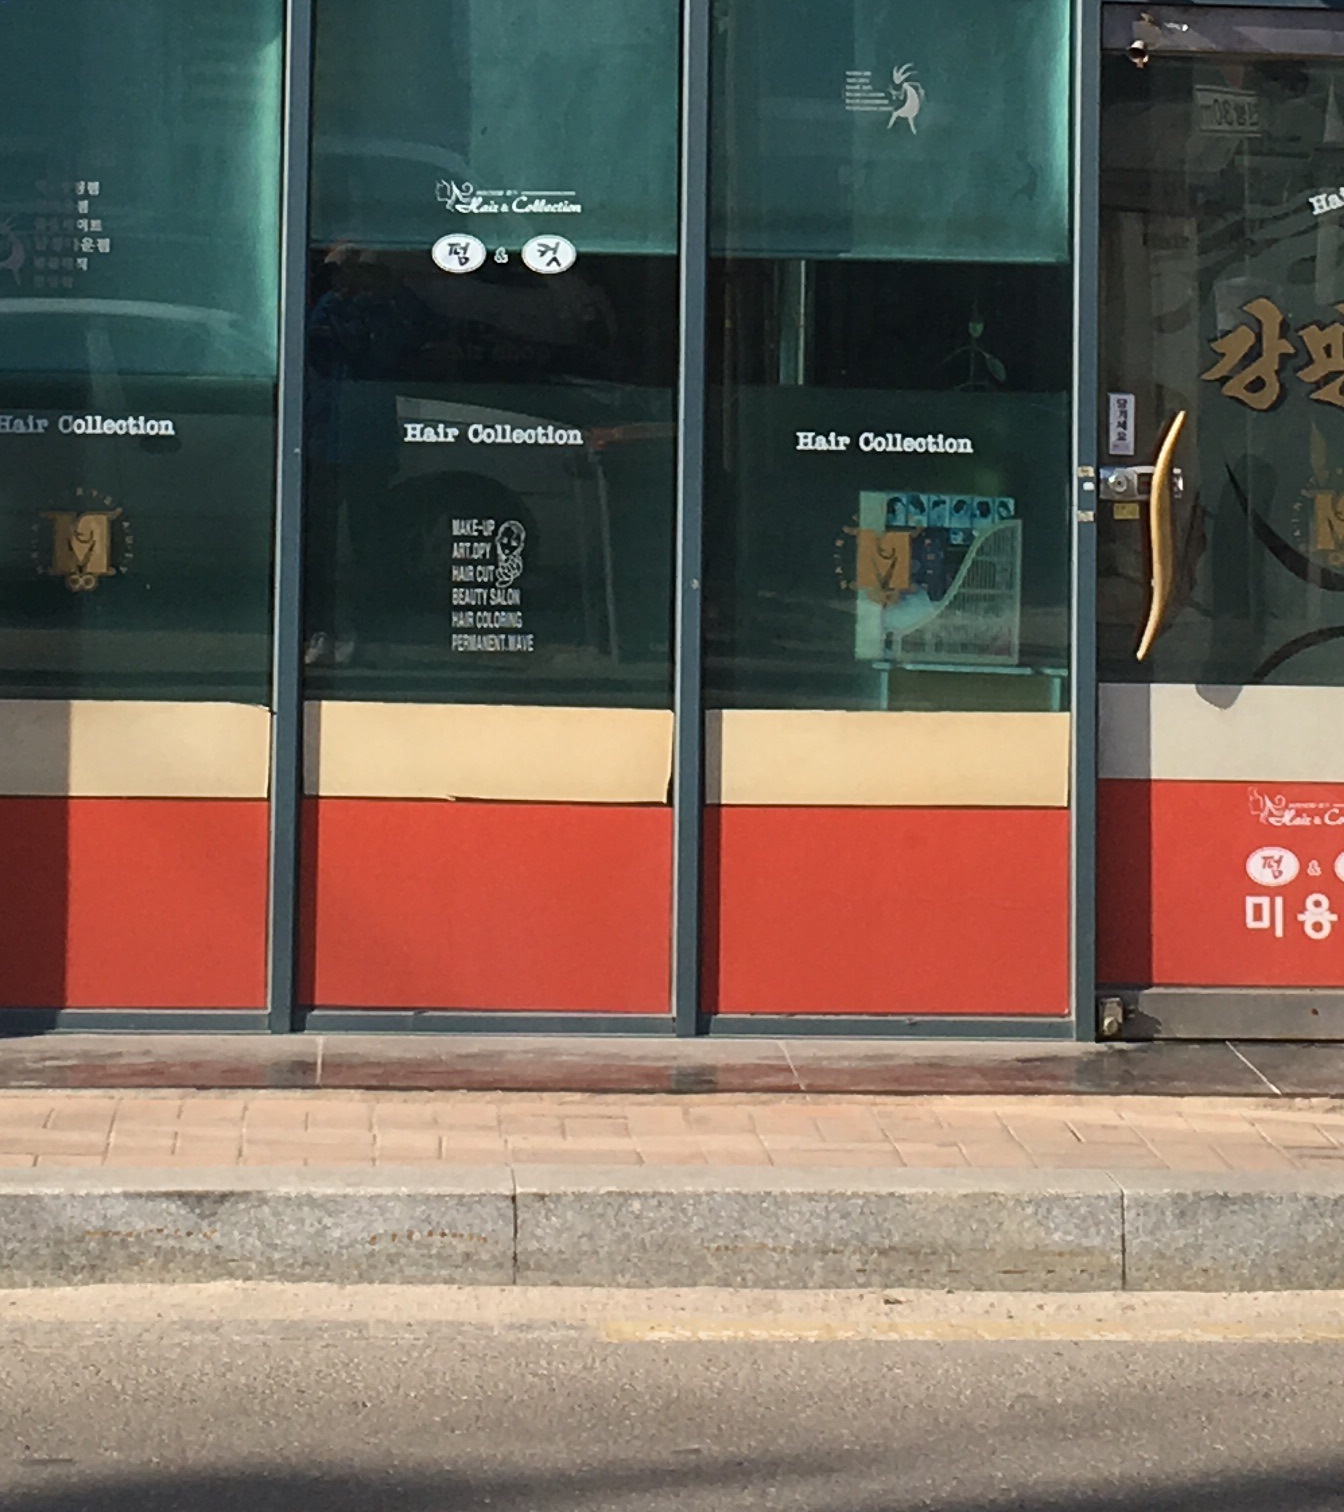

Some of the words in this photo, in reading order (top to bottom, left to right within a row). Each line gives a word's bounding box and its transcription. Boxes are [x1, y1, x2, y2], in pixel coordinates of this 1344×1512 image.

[511, 196, 582, 213] Collection
[494, 247, 509, 264] &
[58, 415, 176, 436] Collection
[404, 423, 460, 442] Hair
[467, 424, 584, 445] Collection
[795, 431, 851, 451] Hair
[858, 432, 974, 454] Collection
[452, 519, 495, 536] MAKE-UP
[452, 565, 474, 582] HAIR
[476, 565, 495, 582] CUT
[452, 588, 488, 605] BEAUTY
[489, 588, 521, 605] SALON
[452, 611, 474, 628] HAIR
[476, 611, 523, 628] COLORING
[1307, 860, 1322, 877] &
